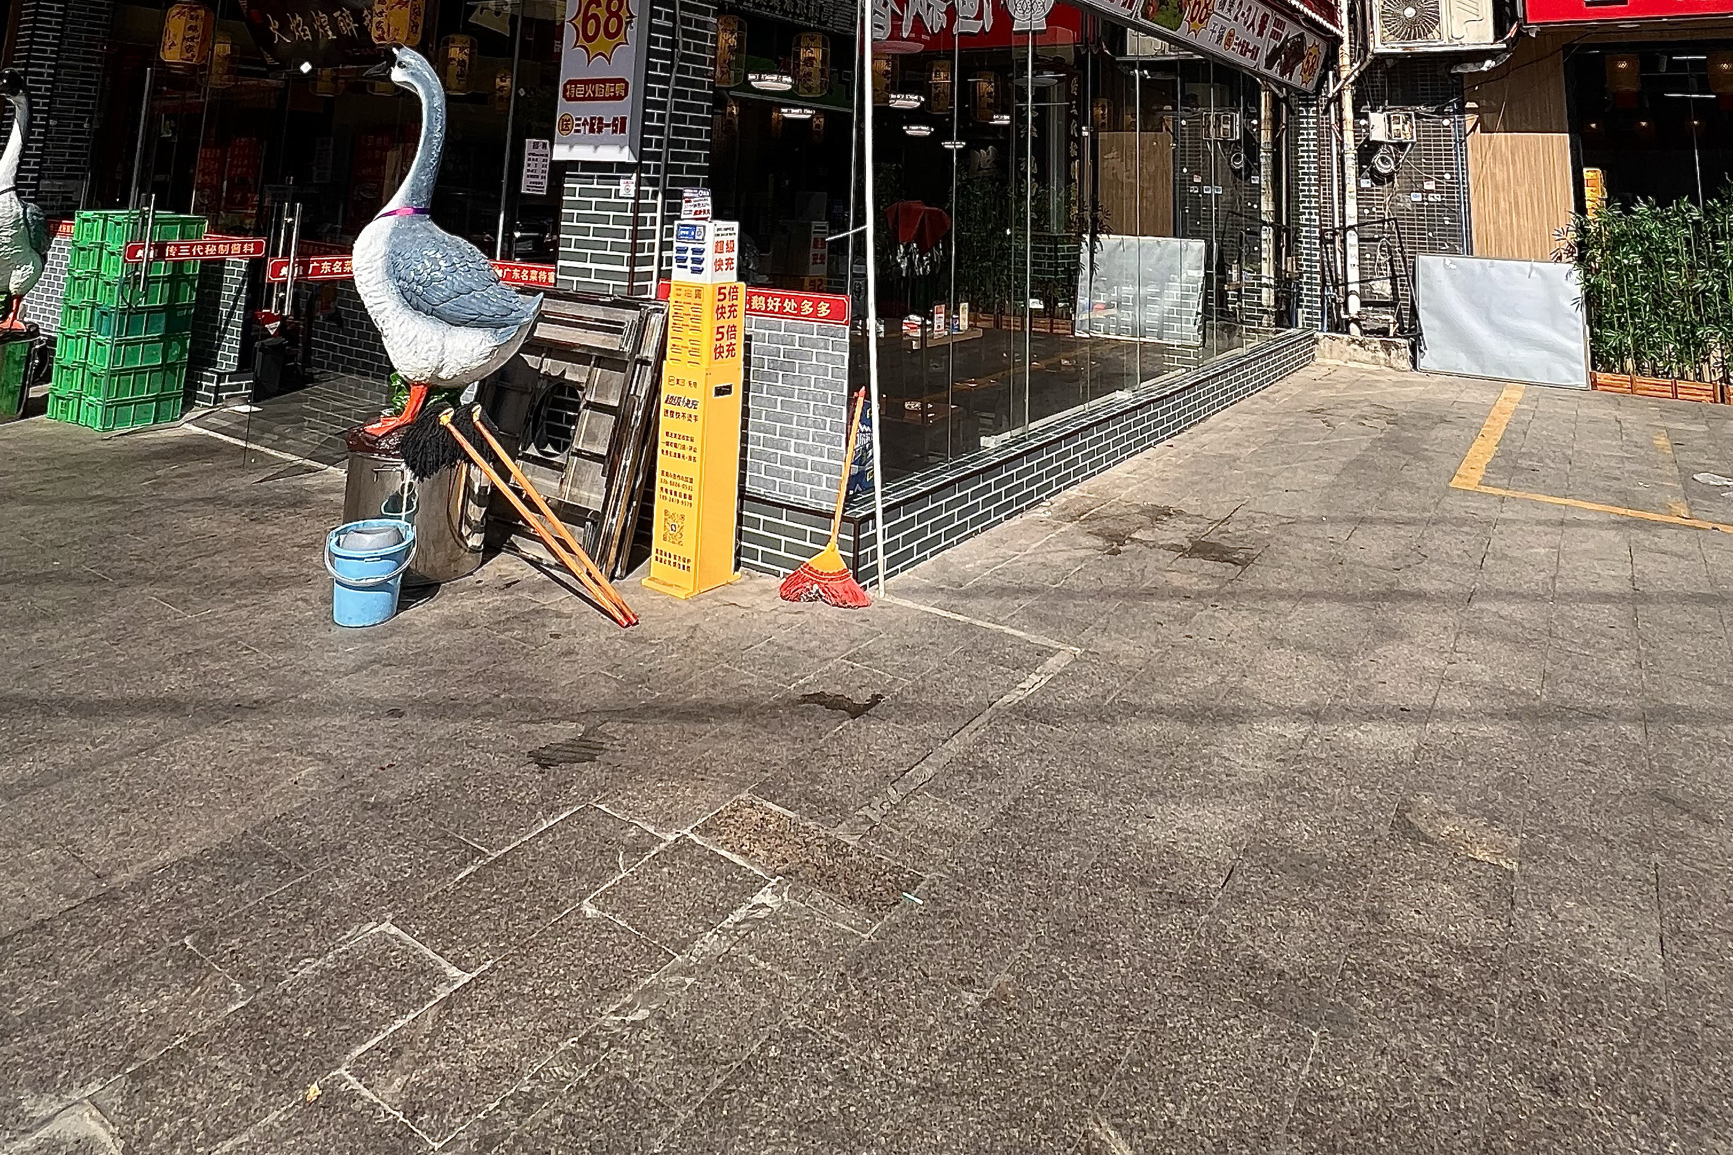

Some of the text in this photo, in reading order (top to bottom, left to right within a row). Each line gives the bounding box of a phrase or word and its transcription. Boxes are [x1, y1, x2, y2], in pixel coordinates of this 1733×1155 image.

[714, 239, 736, 254] 超级
[713, 257, 736, 273] 快充
[716, 285, 740, 302] 5倍
[715, 304, 739, 321] 快充
[715, 324, 738, 342] 5倍
[713, 341, 737, 361] 快充
